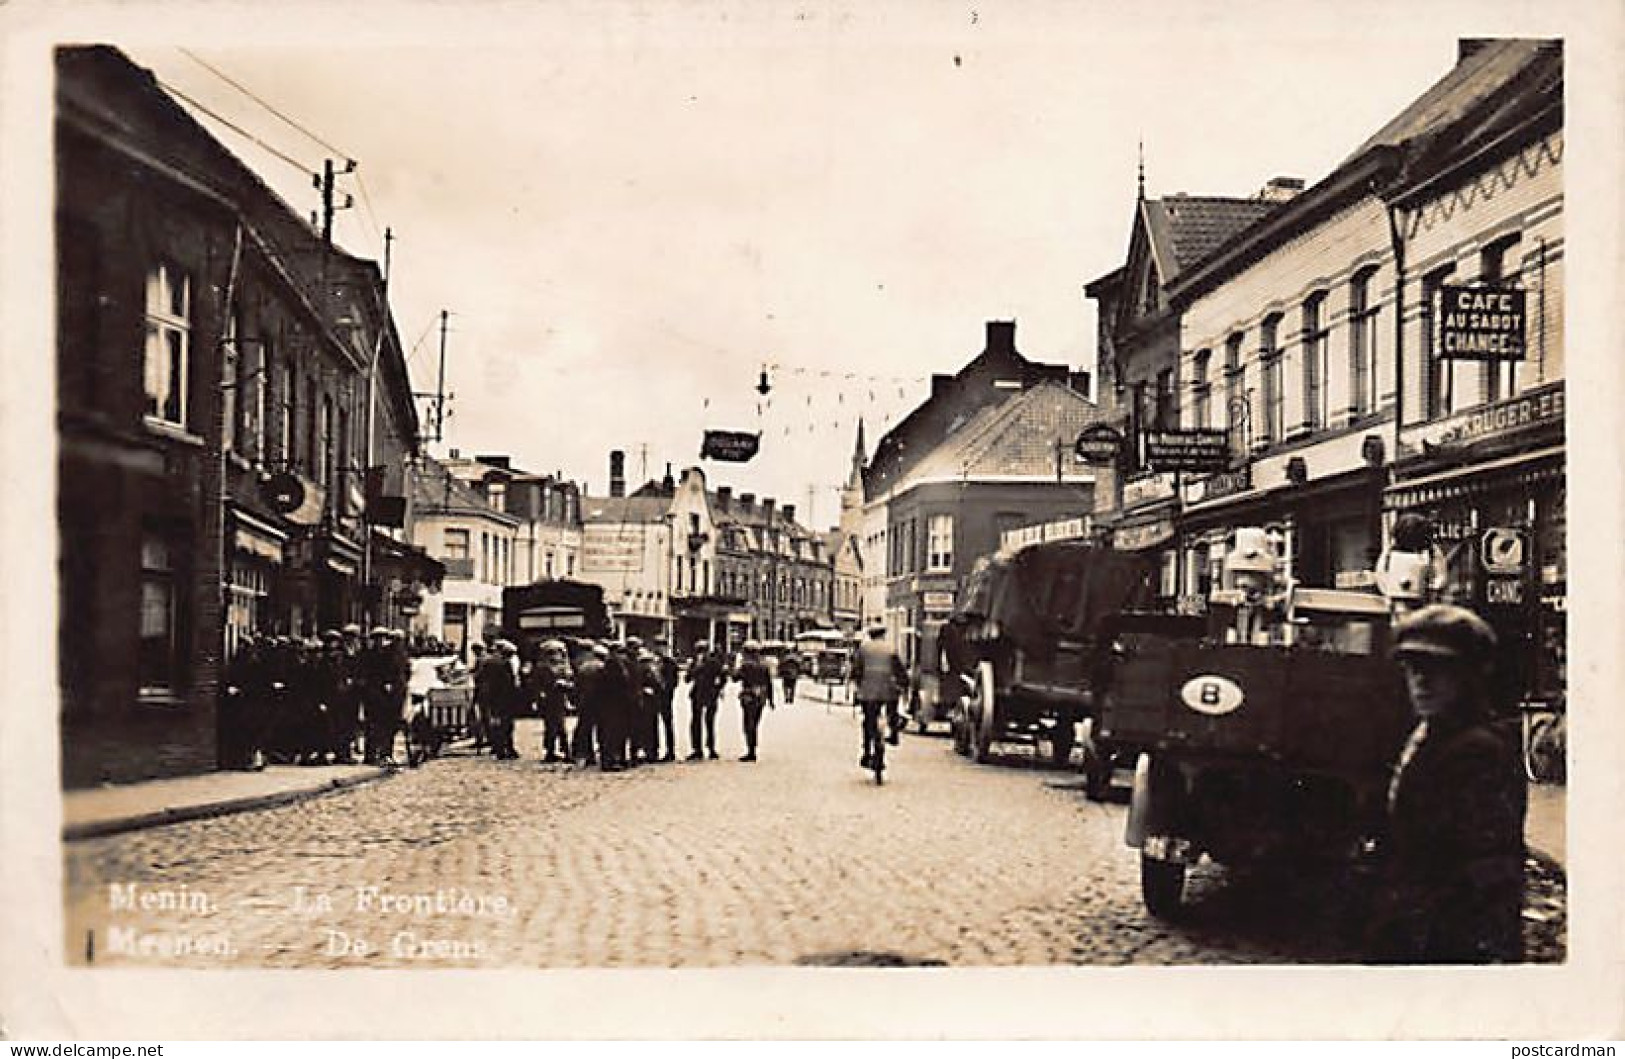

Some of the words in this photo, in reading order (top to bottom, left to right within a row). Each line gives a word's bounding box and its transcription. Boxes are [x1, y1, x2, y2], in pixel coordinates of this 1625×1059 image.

[1458, 292, 1512, 311] CAFE
[1446, 313, 1466, 329] AU
[1470, 313, 1521, 330] SABOT
[1201, 683, 1220, 705] B
